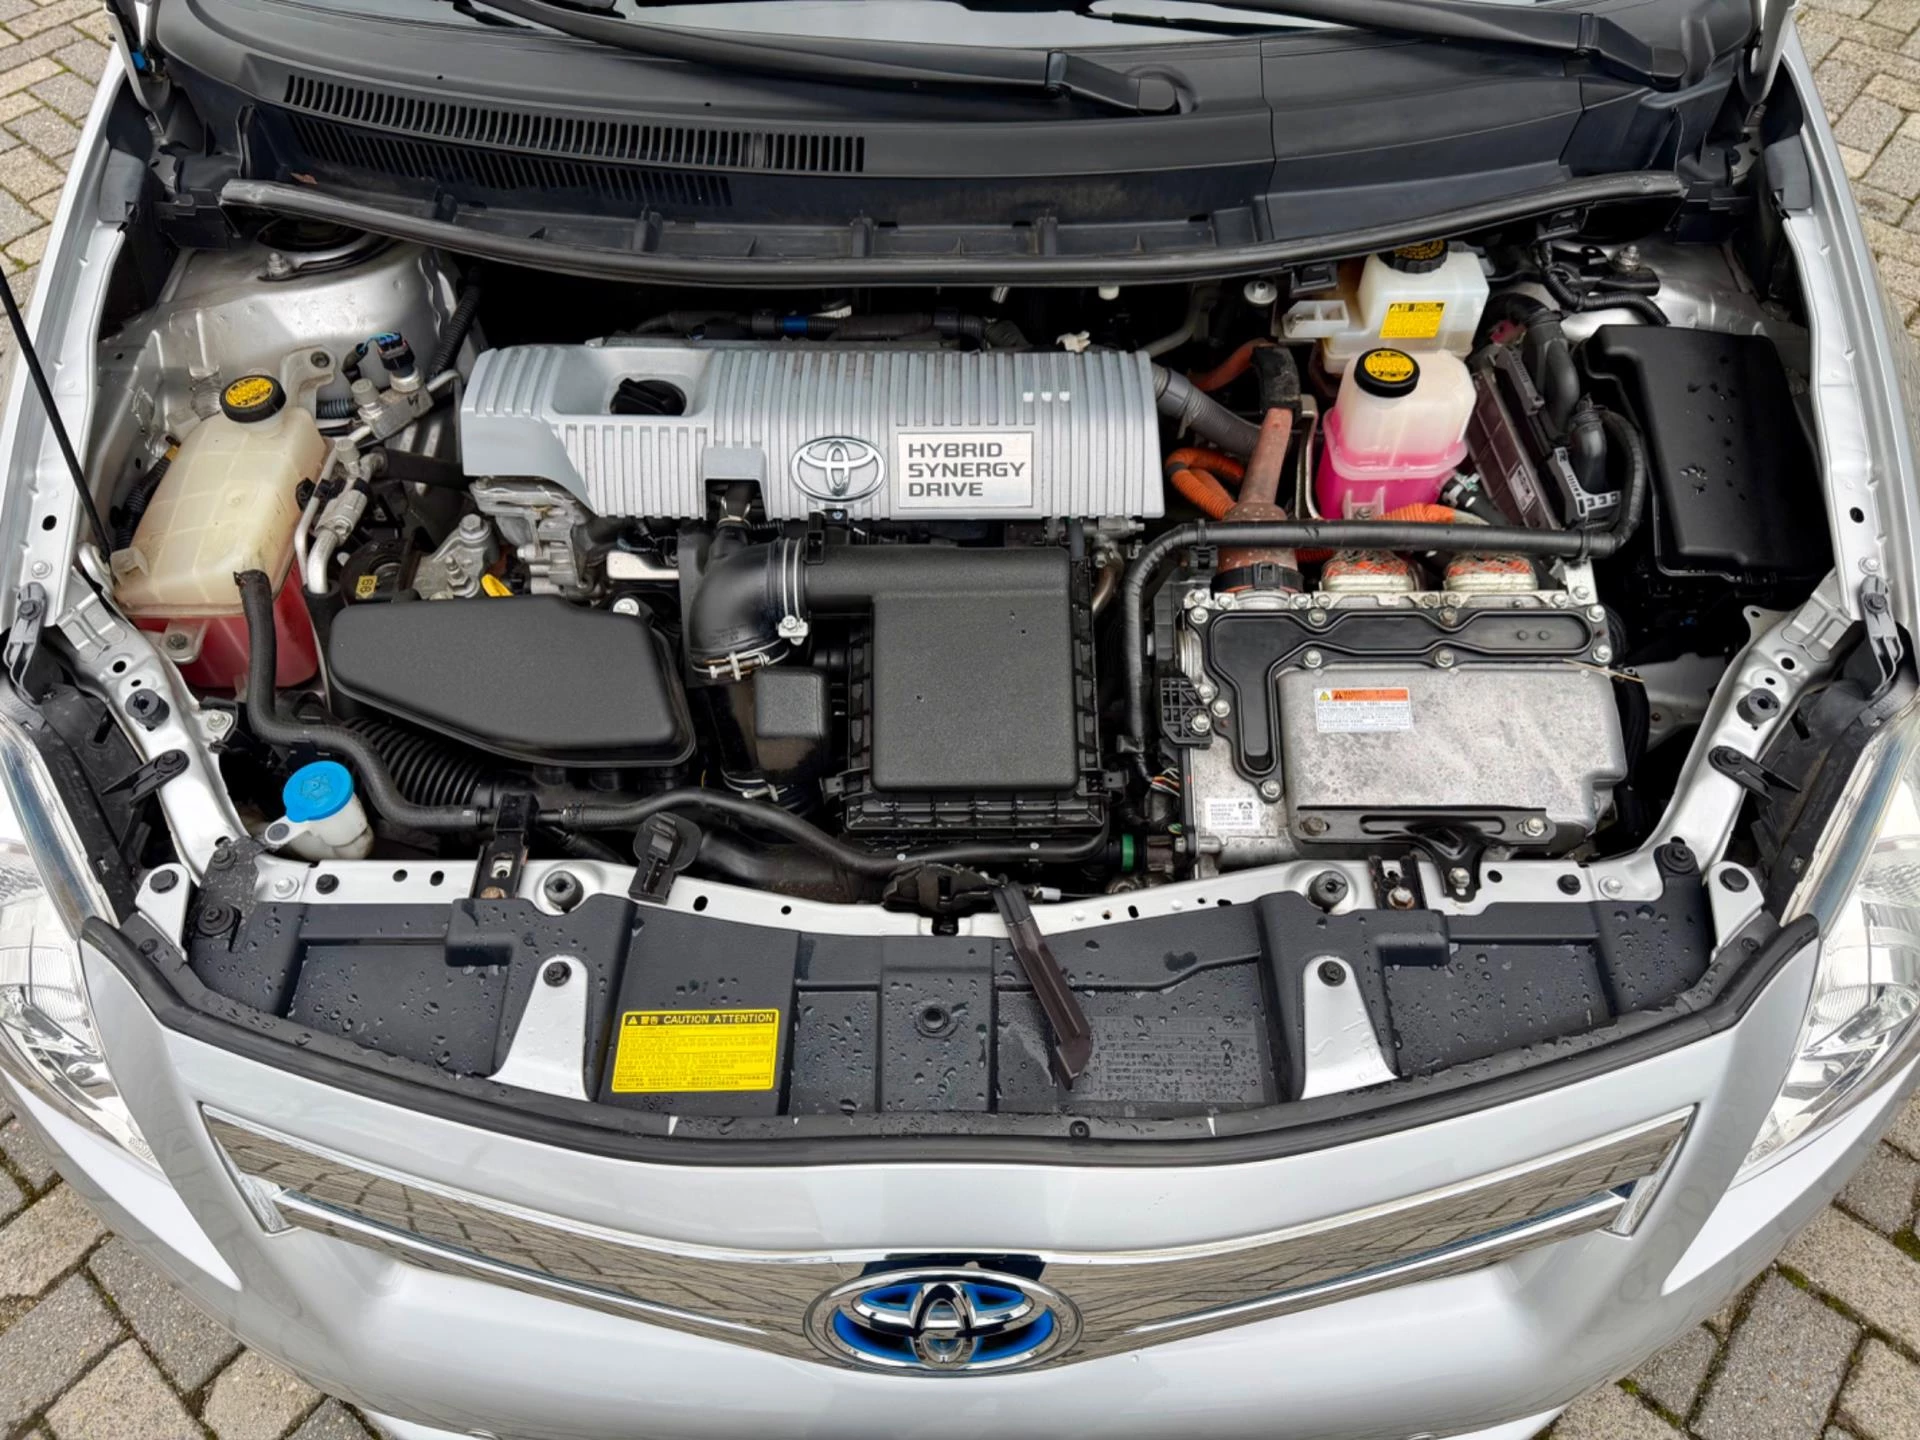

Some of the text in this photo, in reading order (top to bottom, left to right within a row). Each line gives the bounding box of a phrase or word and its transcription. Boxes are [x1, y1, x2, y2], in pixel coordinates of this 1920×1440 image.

[908, 442, 1003, 458] HYBRID
[908, 462, 1025, 478] SYNERGY
[908, 482, 984, 497] DRIVE
[663, 1013, 774, 1025] CAUTION ATTENTION
